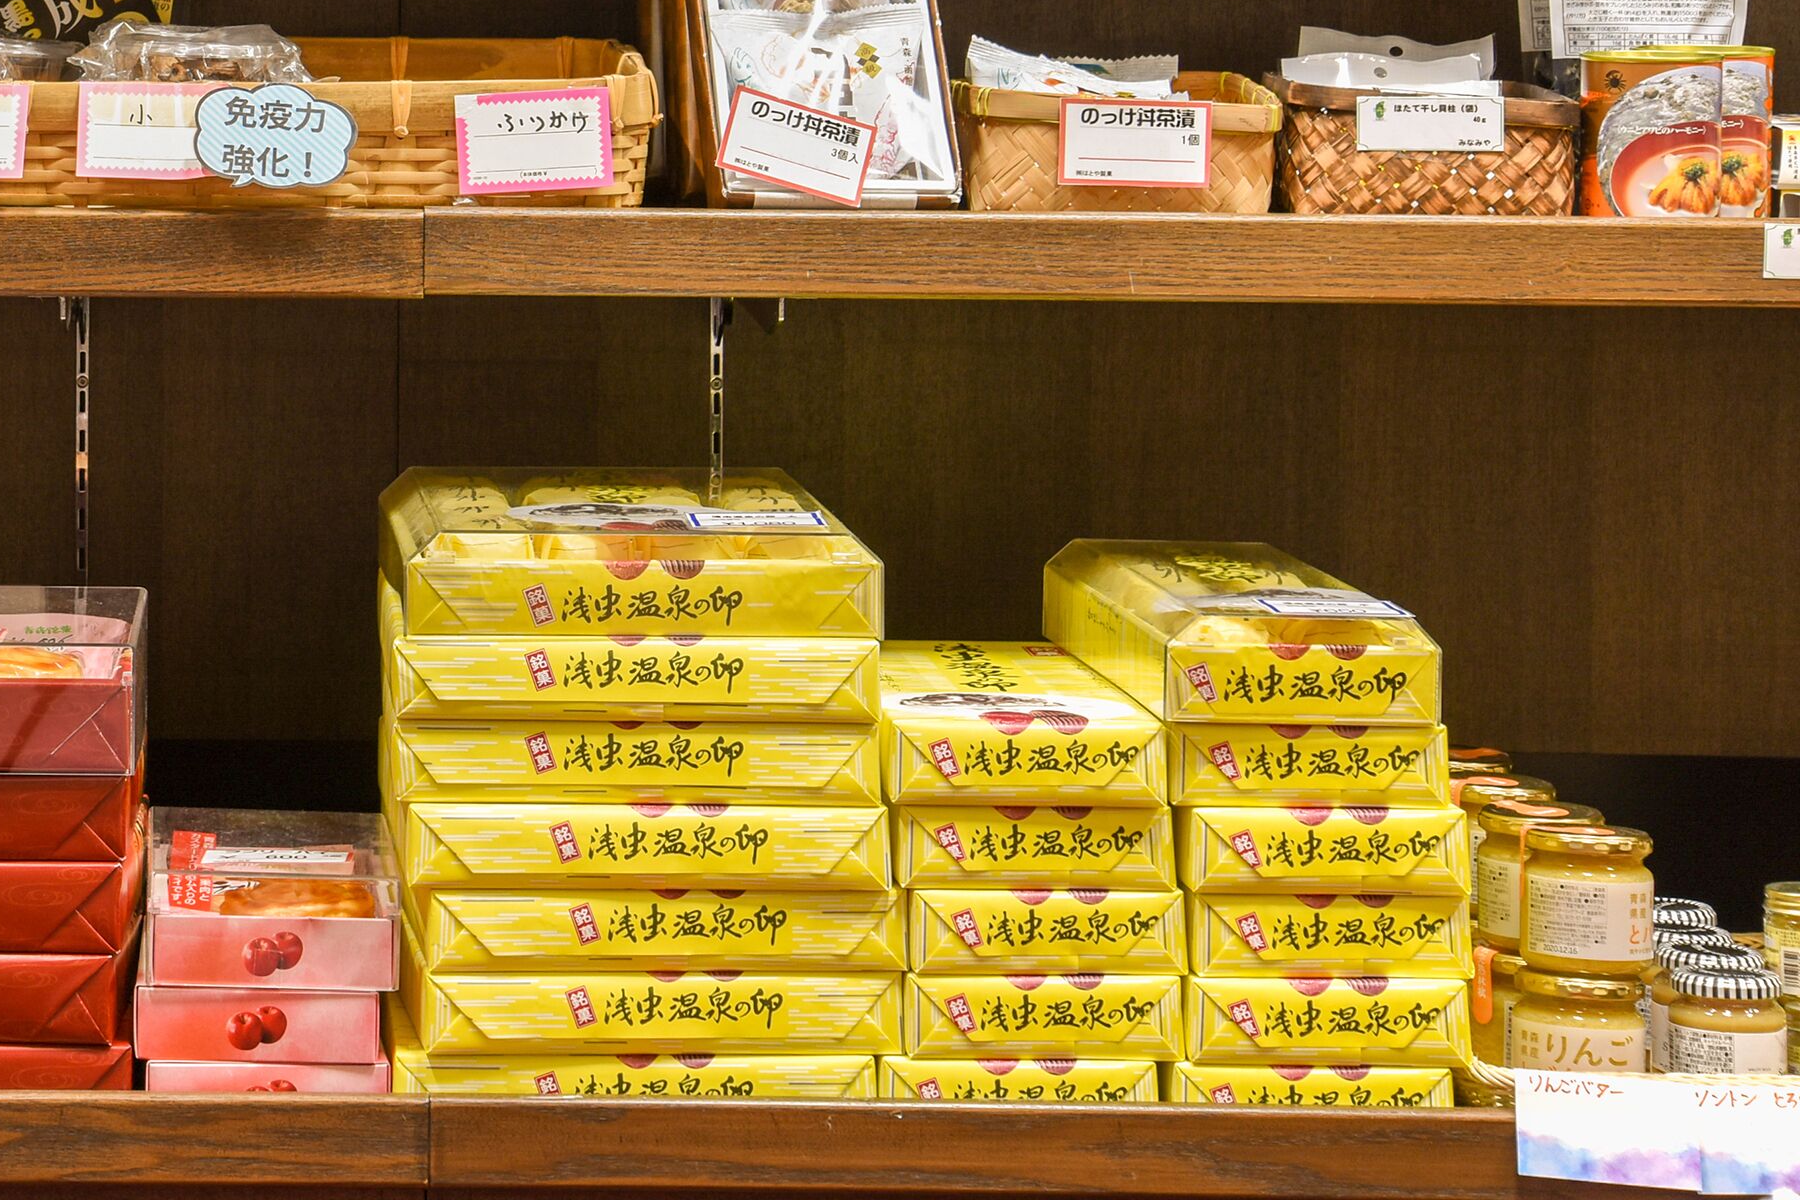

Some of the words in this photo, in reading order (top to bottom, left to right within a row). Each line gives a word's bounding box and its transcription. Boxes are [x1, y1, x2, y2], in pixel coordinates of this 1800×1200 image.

[128, 103, 154, 126] 小
[225, 96, 327, 133] 免疫力
[497, 111, 588, 134] ふりかけ
[750, 100, 861, 147] のっけ丼茶漬
[1080, 107, 1196, 130] のっけ丼茶漬
[830, 147, 859, 165] 3個入
[1181, 134, 1200, 147] 1個
[527, 588, 553, 623] 銘菓
[1190, 666, 1213, 701] 銘菓
[1212, 744, 1239, 780] 銘菓
[938, 827, 963, 861] 銘菓
[573, 908, 598, 942] 銘菓
[570, 990, 594, 1025] 銘菓
[1233, 1003, 1260, 1037] 銘菓
[1546, 1032, 1634, 1067] りんご
[1529, 1074, 1625, 1099] りんごバター
[1695, 1090, 1758, 1108] ソントン
[1773, 1091, 1800, 1109] とろ
